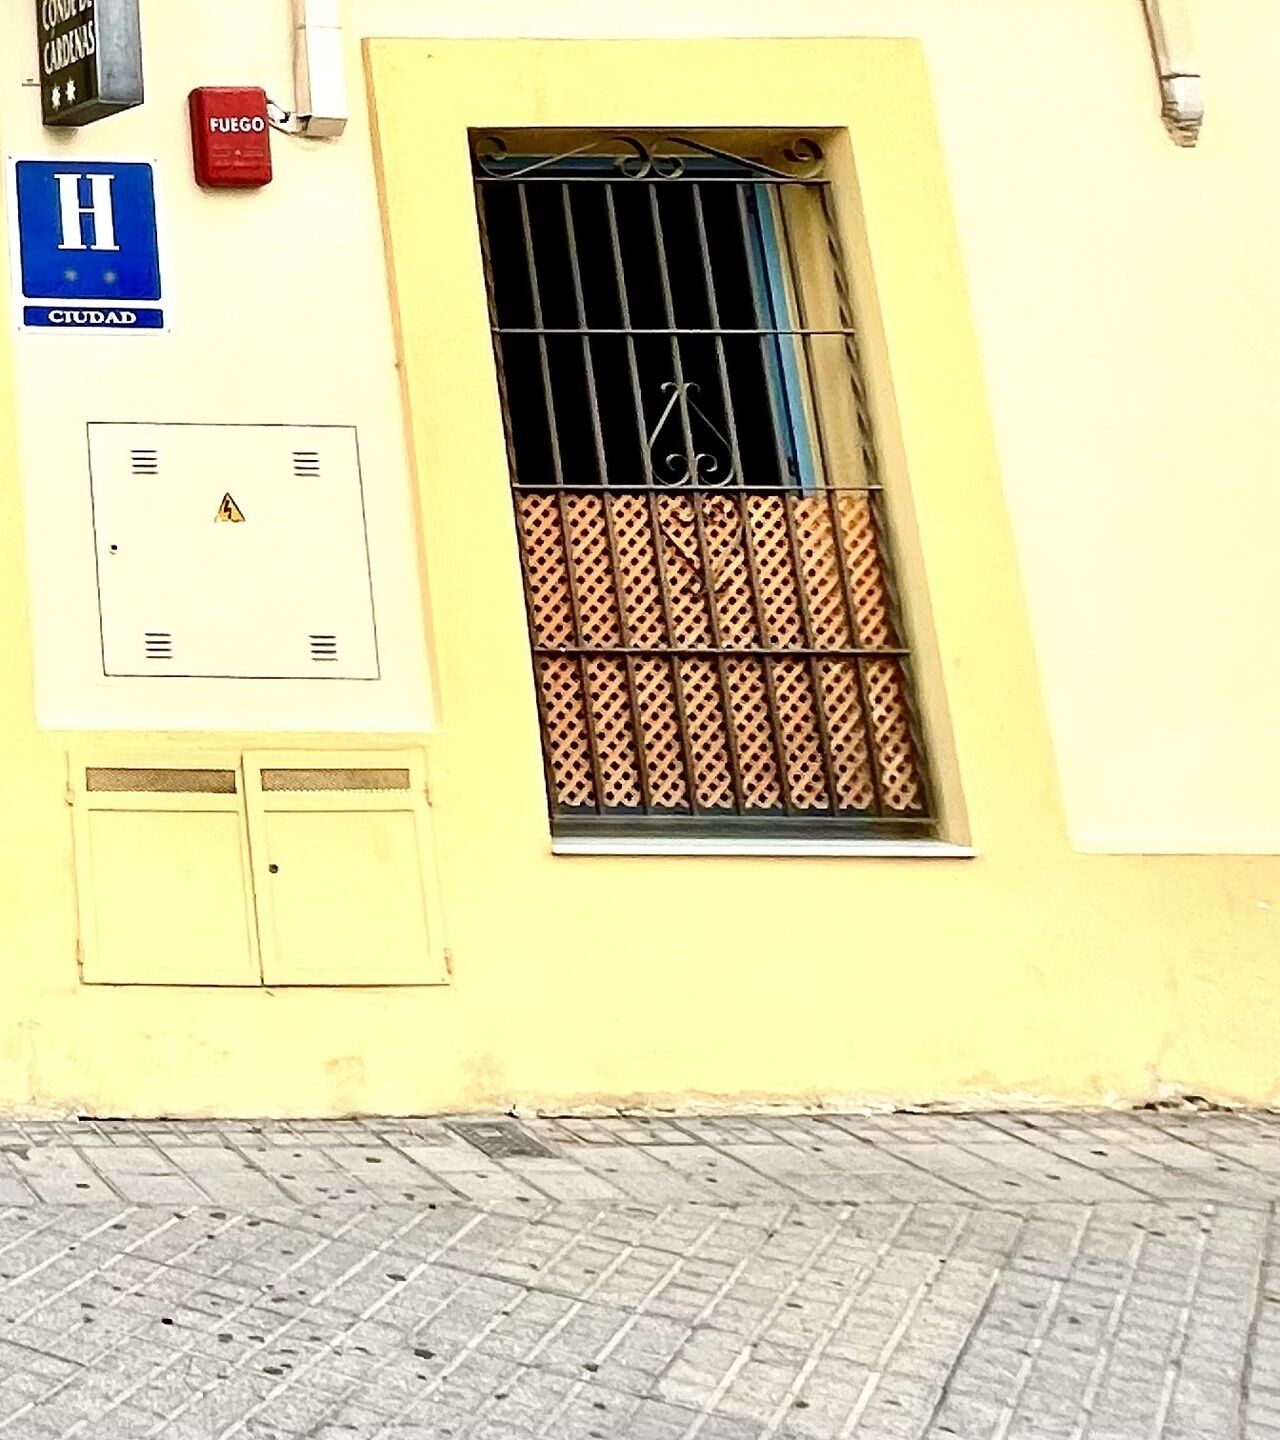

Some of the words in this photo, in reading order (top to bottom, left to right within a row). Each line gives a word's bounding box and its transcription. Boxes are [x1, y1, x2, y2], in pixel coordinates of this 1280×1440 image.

[210, 116, 265, 133] FUEGO
[53, 173, 120, 251] H
[48, 310, 137, 324] CIUDAD
